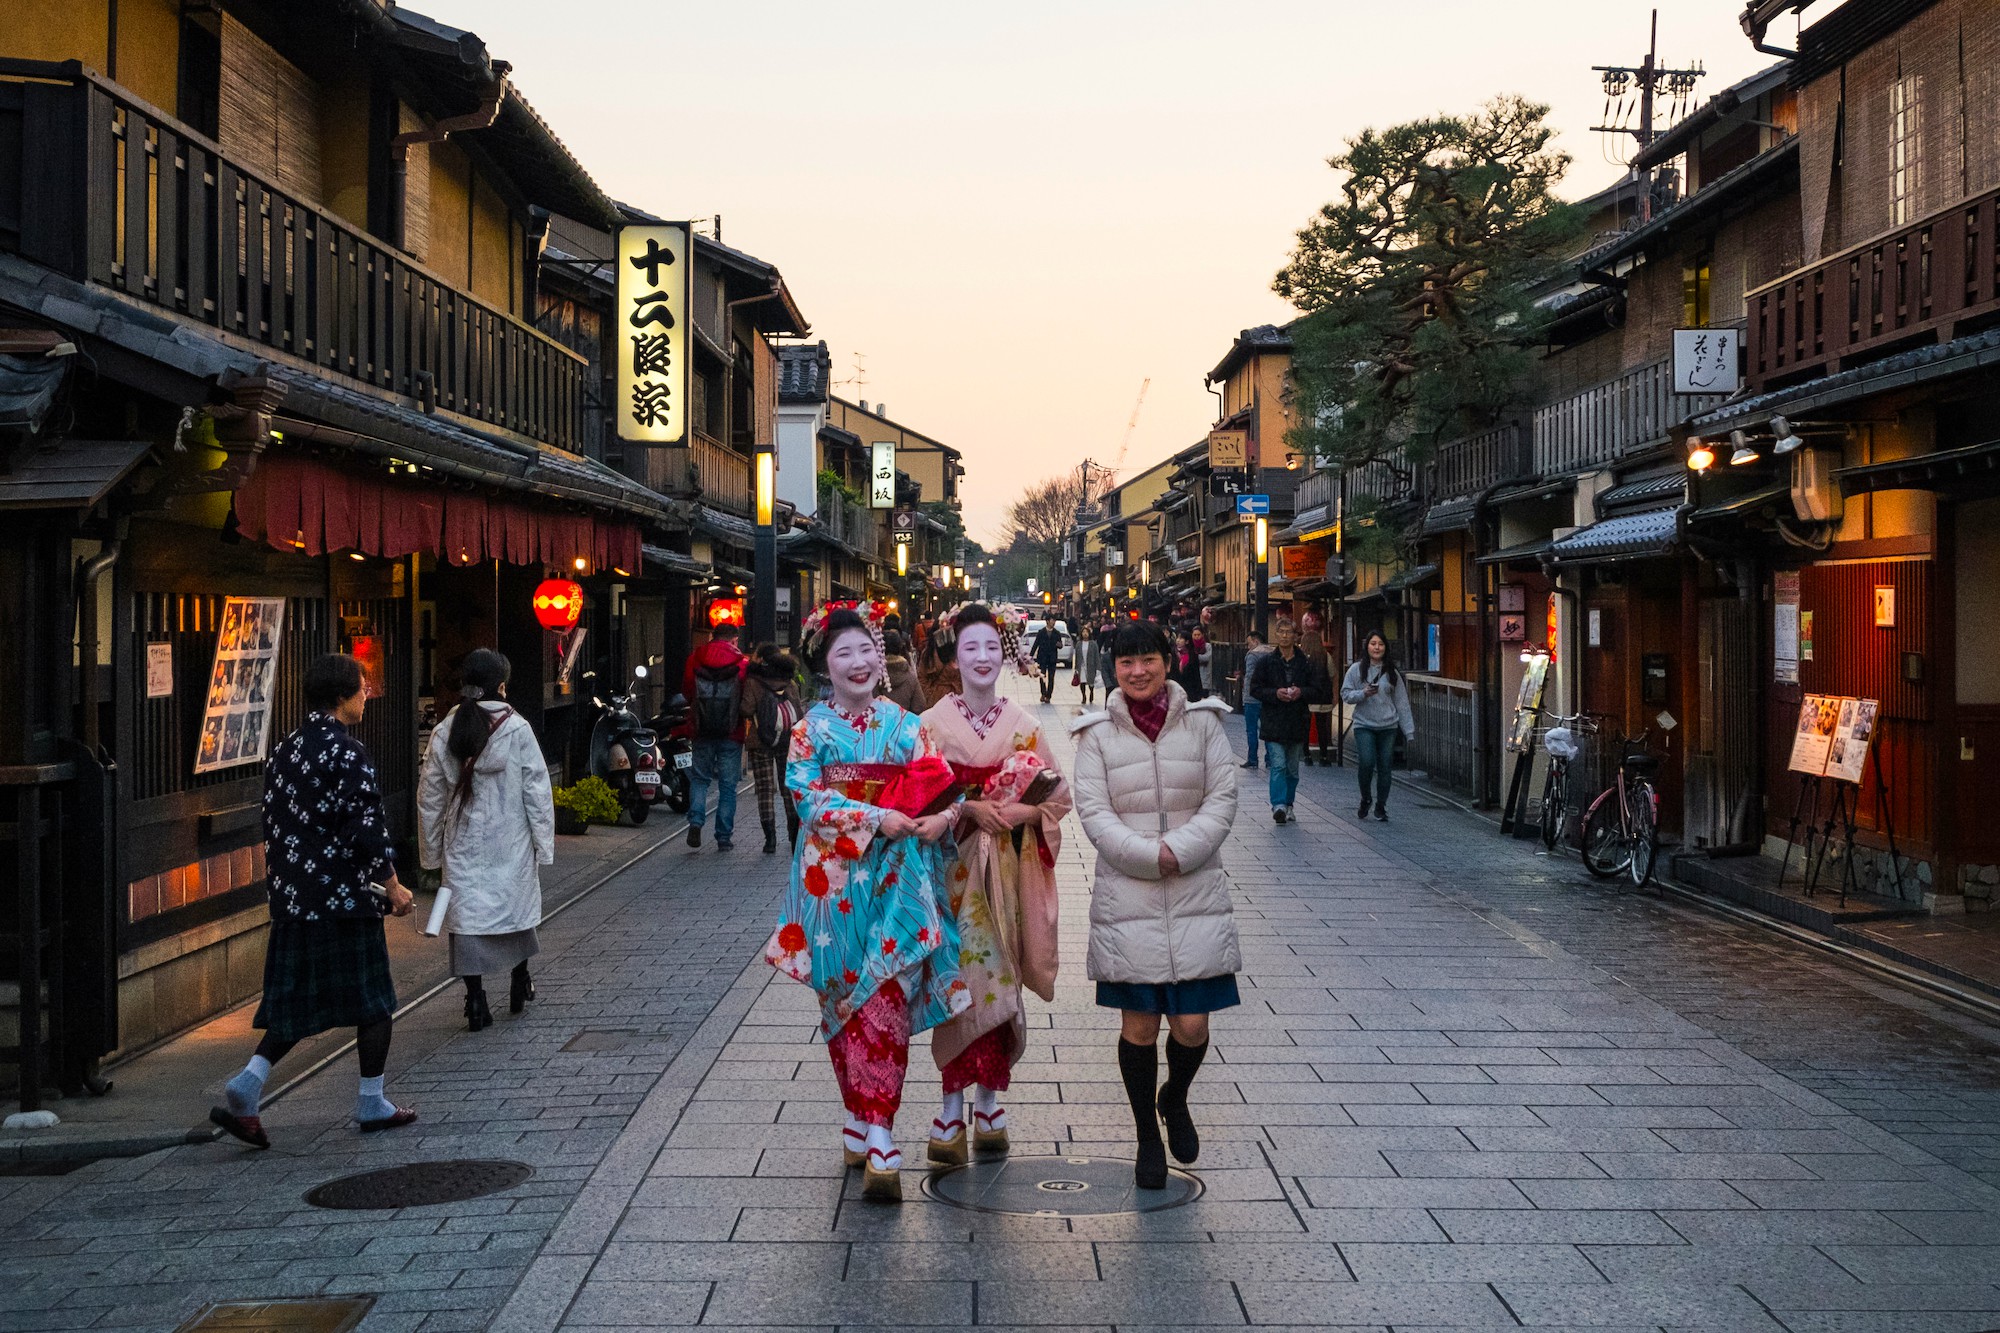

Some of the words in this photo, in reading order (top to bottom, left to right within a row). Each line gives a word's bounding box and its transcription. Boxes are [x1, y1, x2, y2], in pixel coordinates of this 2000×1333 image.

[629, 238, 676, 428] 十二段家
[875, 467, 892, 500] 西坂
